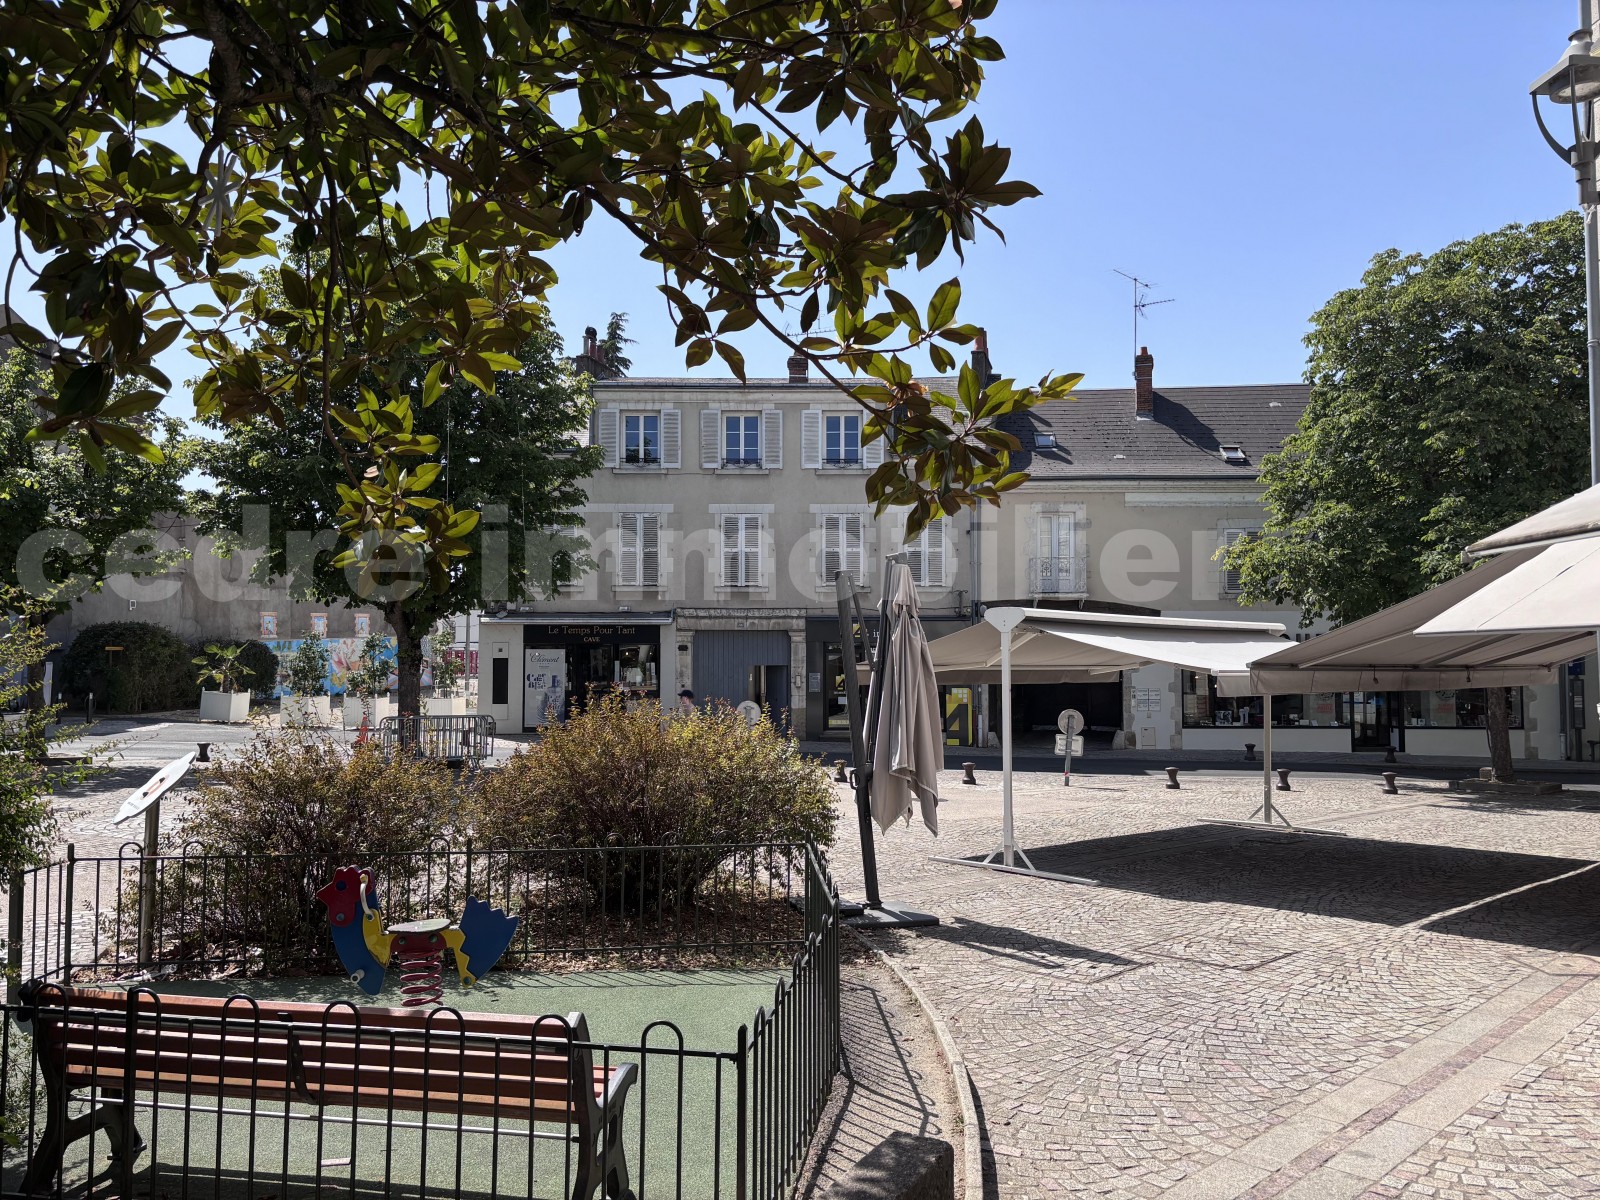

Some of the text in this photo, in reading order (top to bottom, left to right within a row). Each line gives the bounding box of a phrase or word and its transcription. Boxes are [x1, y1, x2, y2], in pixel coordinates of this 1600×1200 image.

[548, 625, 636, 636] Le Temps Pour Tant
